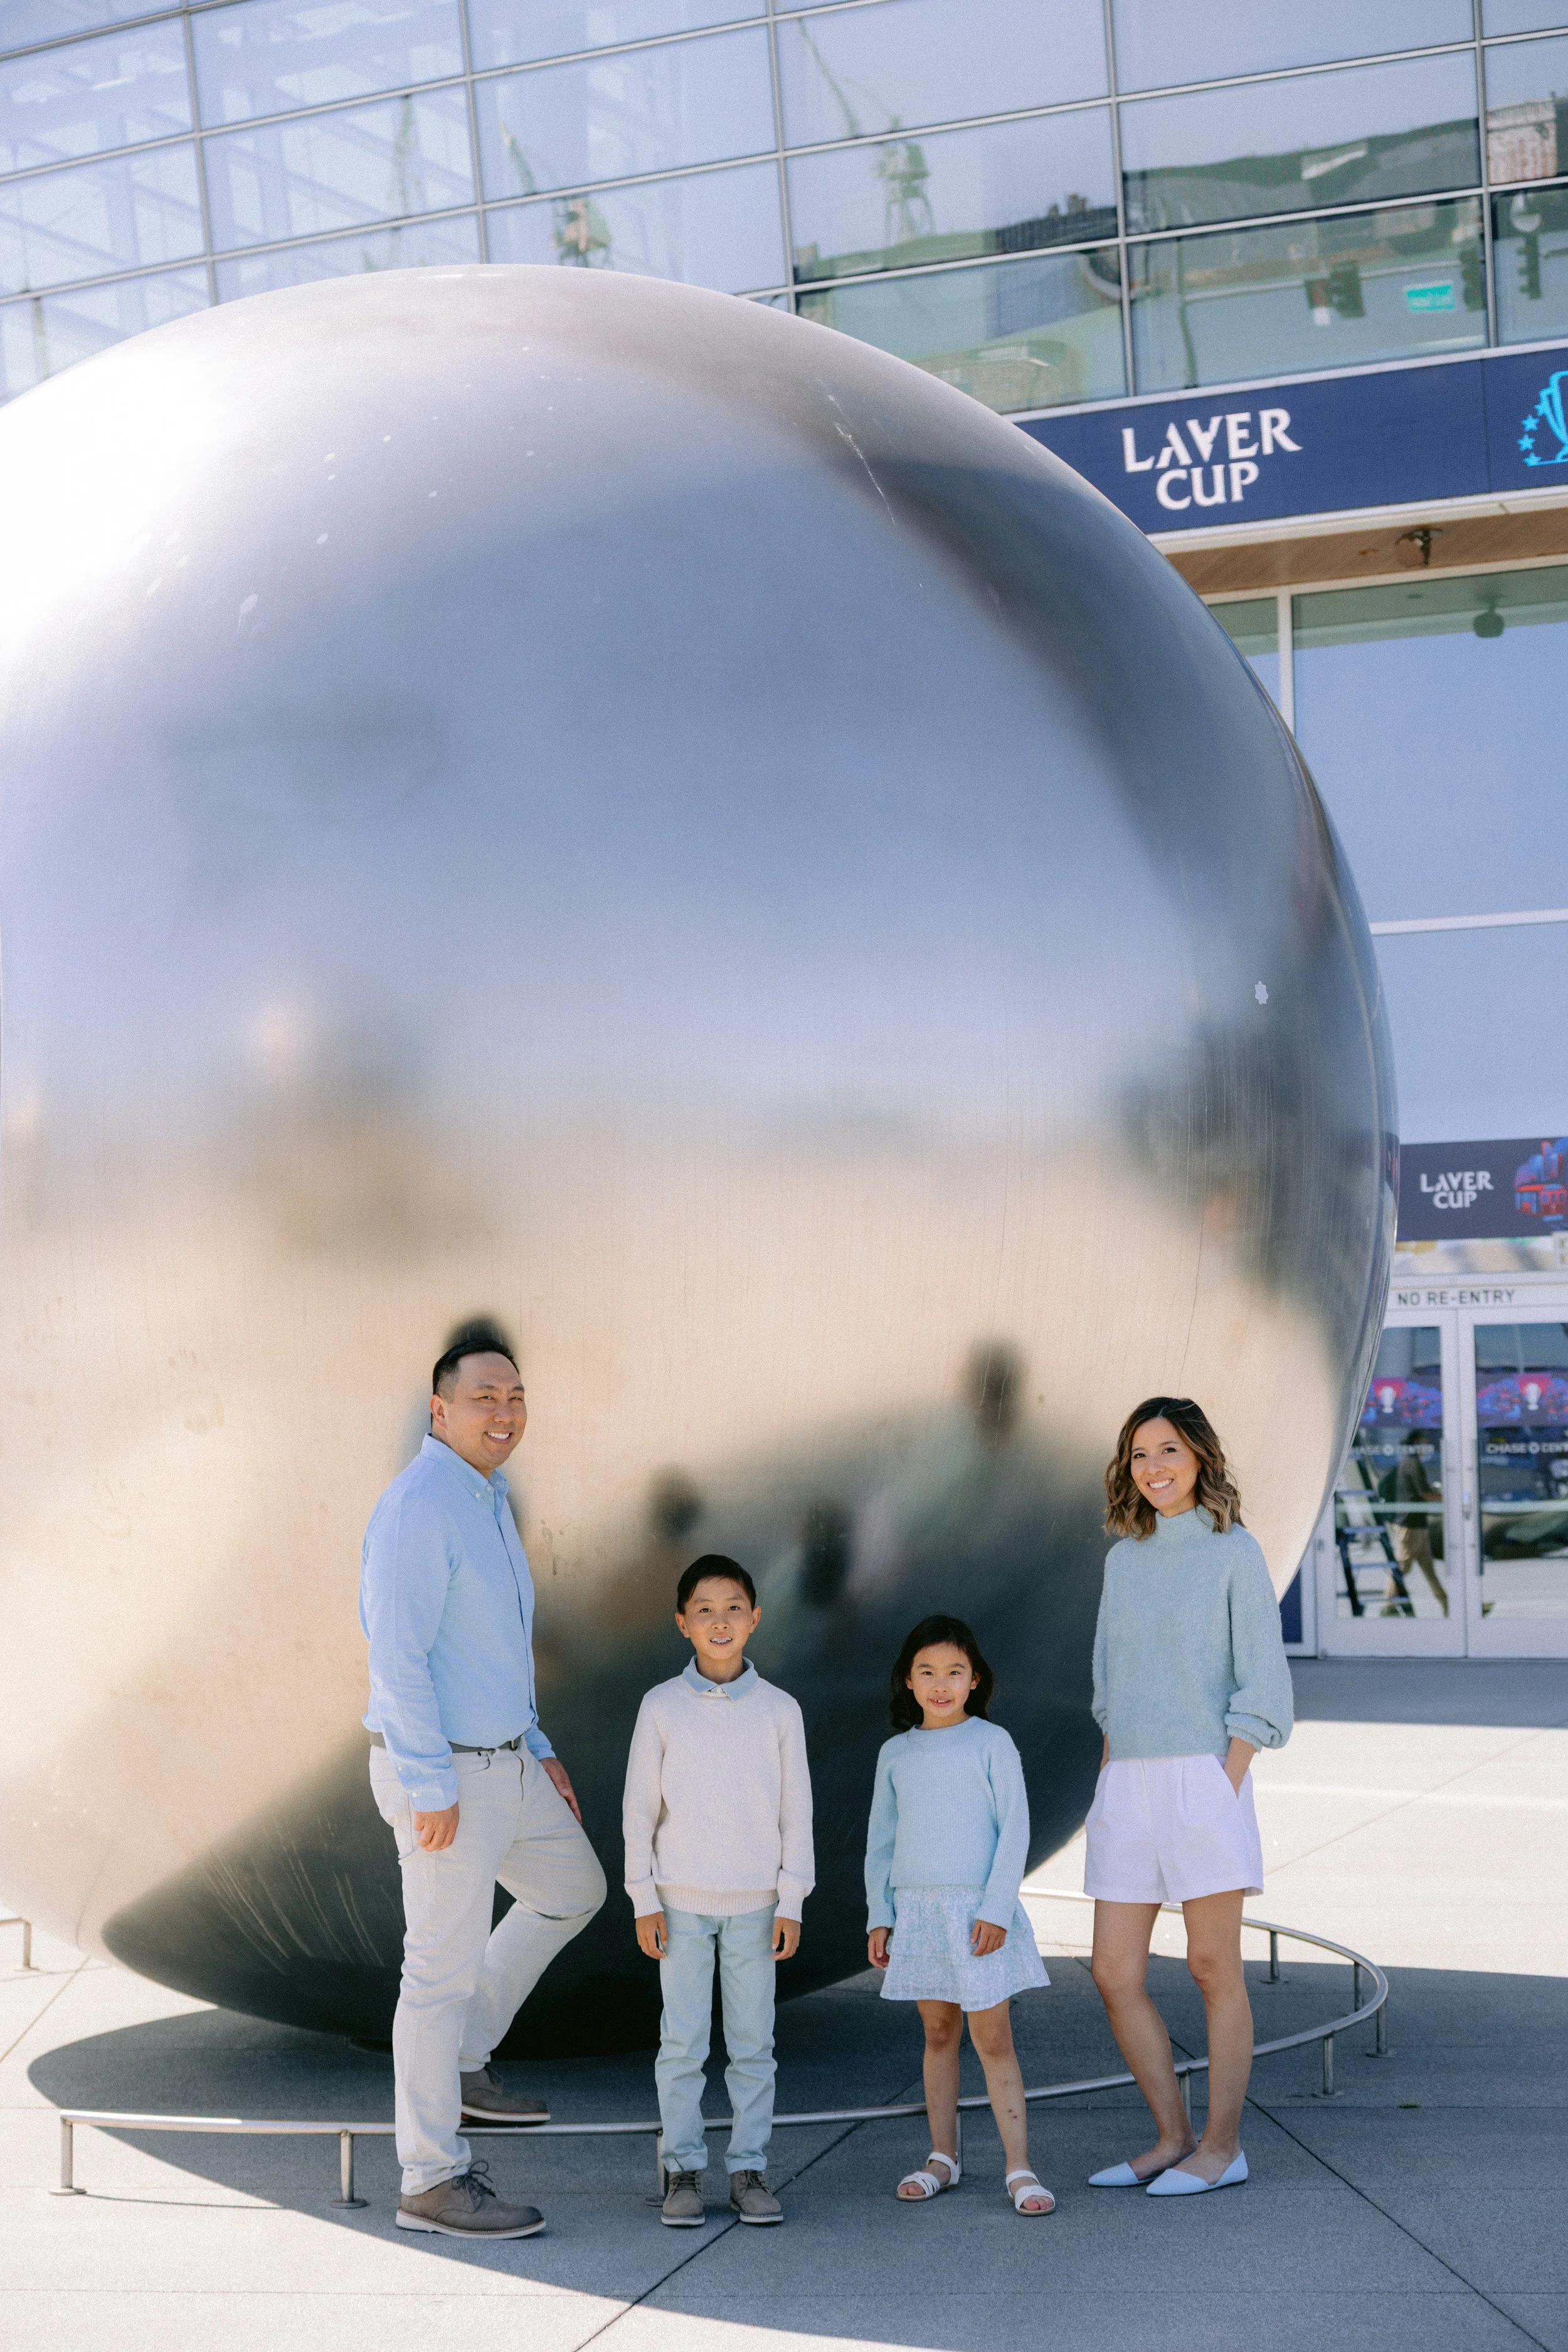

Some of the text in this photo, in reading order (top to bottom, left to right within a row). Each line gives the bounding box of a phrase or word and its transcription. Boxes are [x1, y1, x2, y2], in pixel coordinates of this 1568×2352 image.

[1122, 408, 1303, 473] LAVER
[1156, 462, 1259, 510] CUP
[1420, 1170, 1494, 1192] LAVER
[1433, 1190, 1478, 1209] CUP
[1397, 1289, 1515, 1305] NO RE-ENTRY
[1485, 1443, 1527, 1454] CHASE
